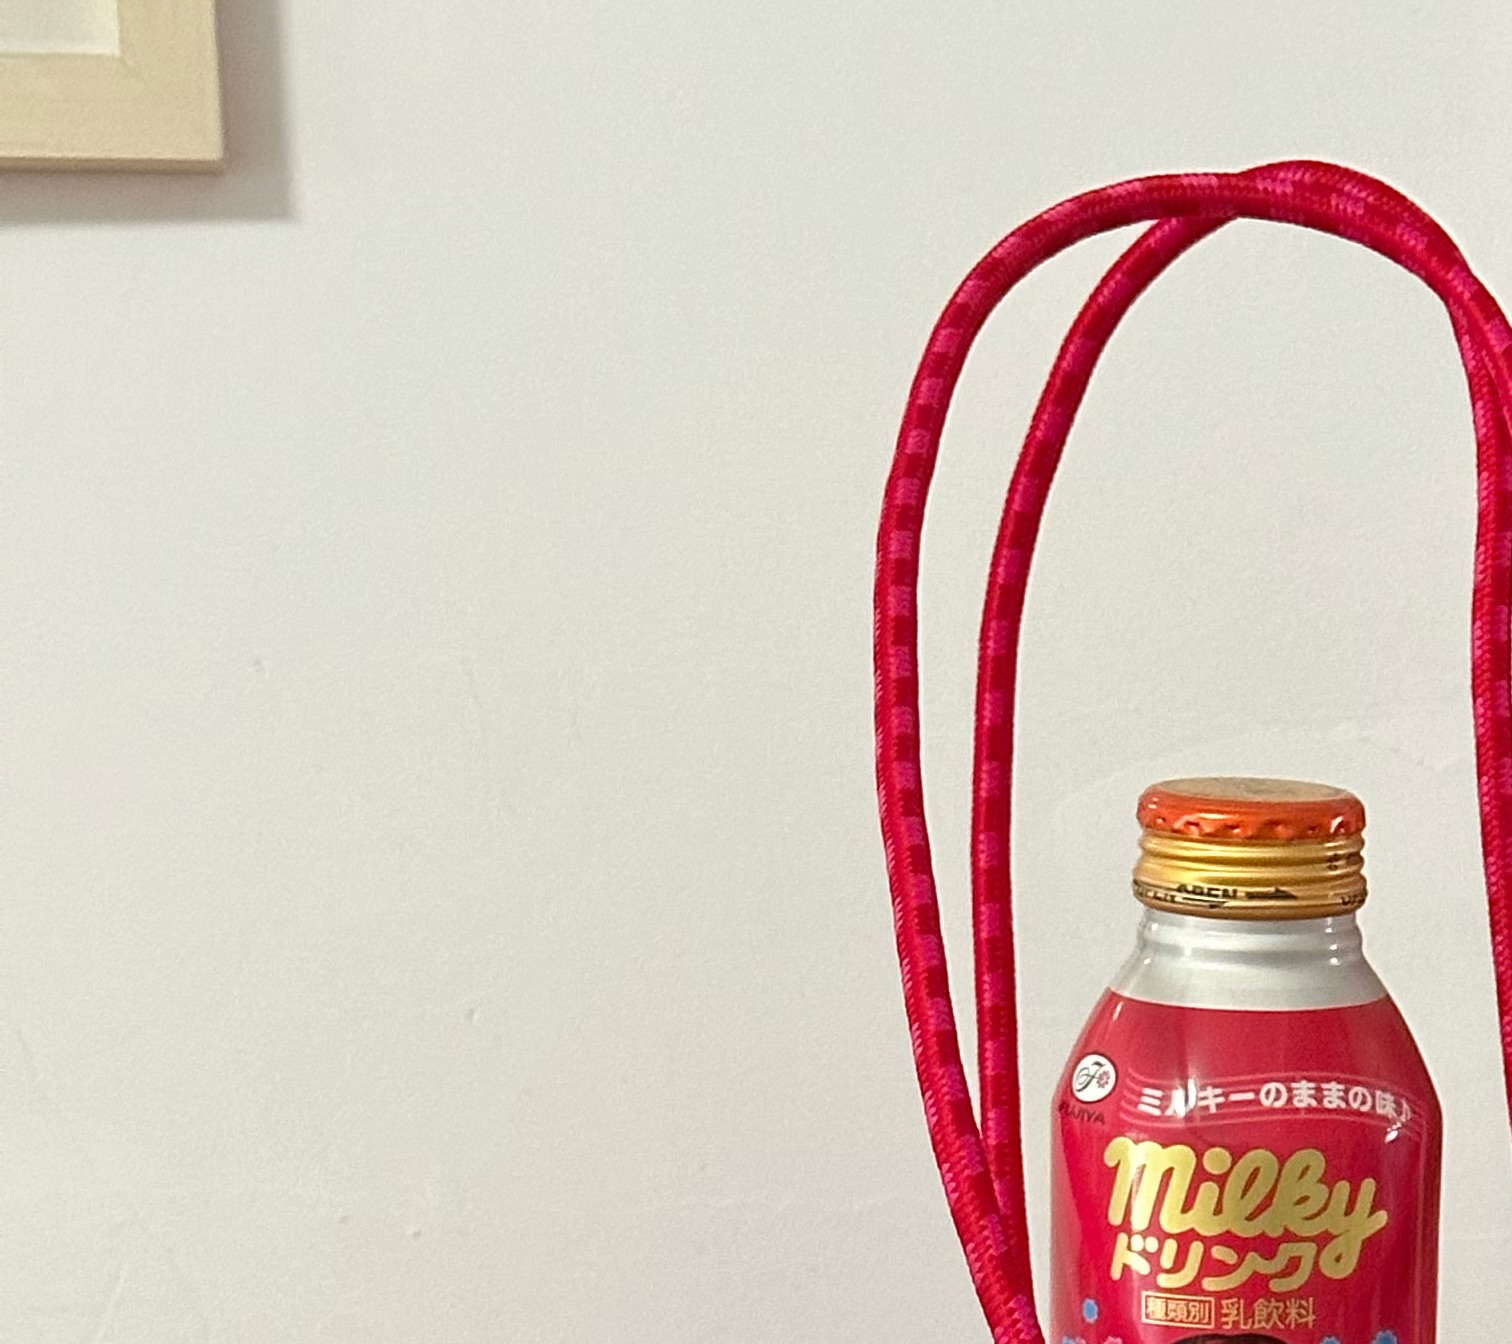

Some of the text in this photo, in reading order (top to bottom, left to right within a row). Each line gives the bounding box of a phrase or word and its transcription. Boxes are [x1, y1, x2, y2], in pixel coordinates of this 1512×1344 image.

[1103, 1136, 1389, 1280] Milky
[1110, 1231, 1318, 1294] ドリンク
[1220, 1296, 1316, 1330] 乳飲料
